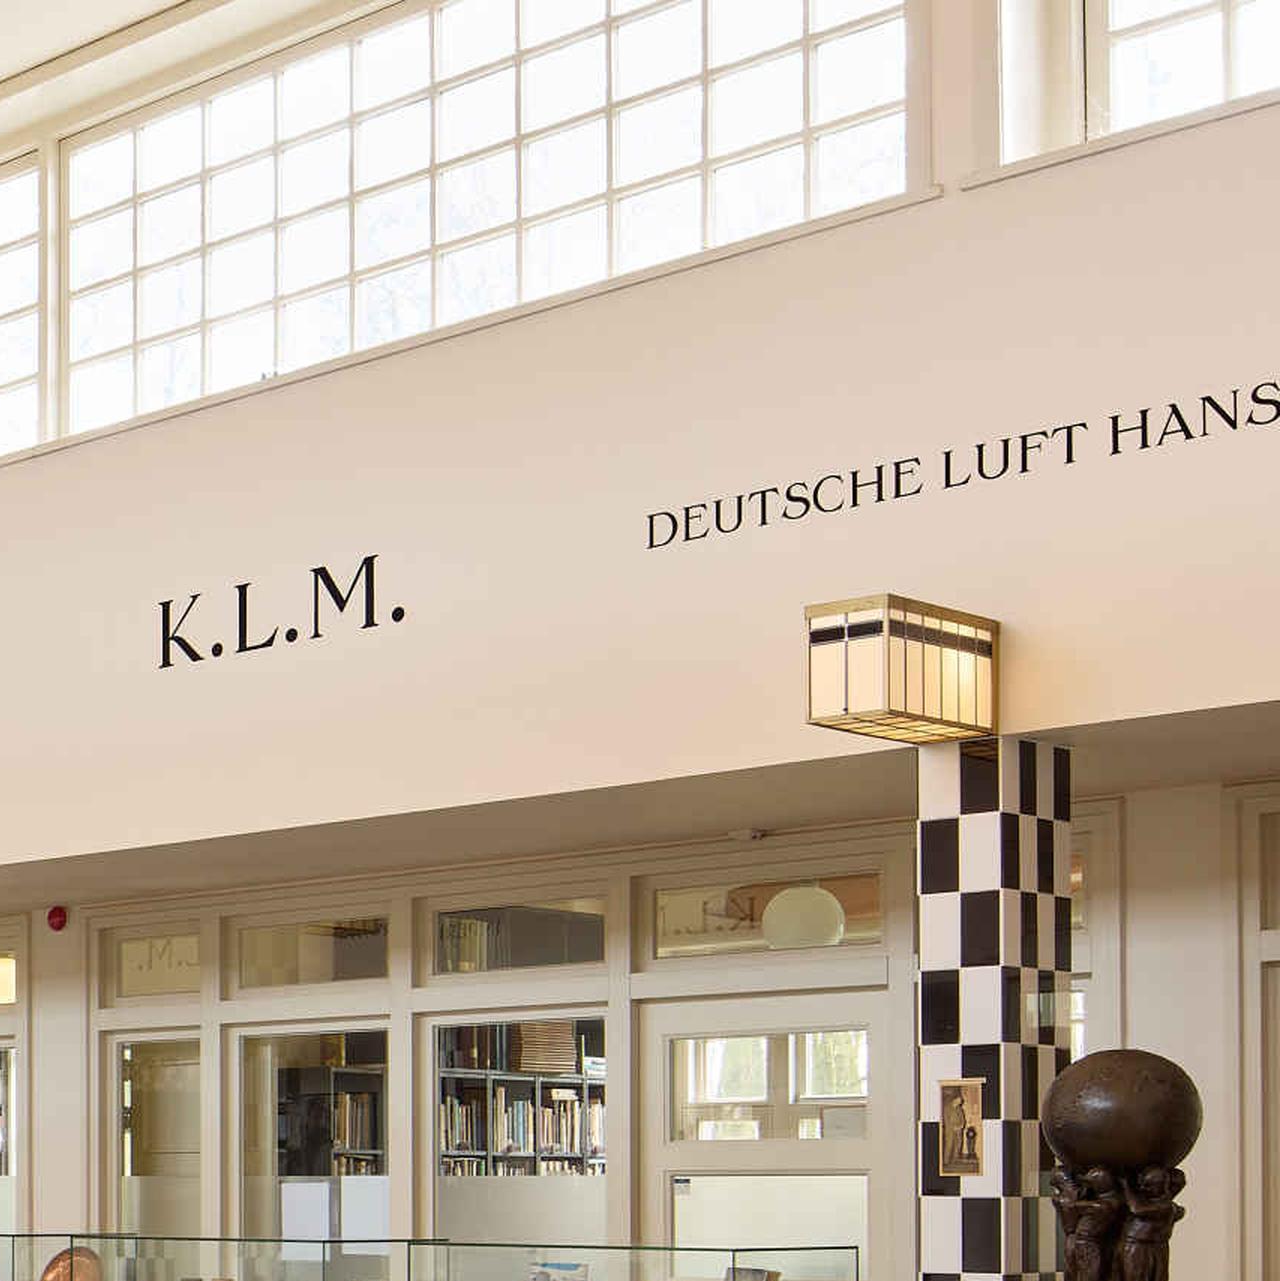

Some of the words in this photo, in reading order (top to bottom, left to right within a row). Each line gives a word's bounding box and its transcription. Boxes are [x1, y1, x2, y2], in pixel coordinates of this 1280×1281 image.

[646, 457, 923, 549] DEUTSCHE
[942, 422, 1088, 489] LUFT
[1108, 380, 1280, 456] HANS
[158, 554, 405, 669] K.L.M.
